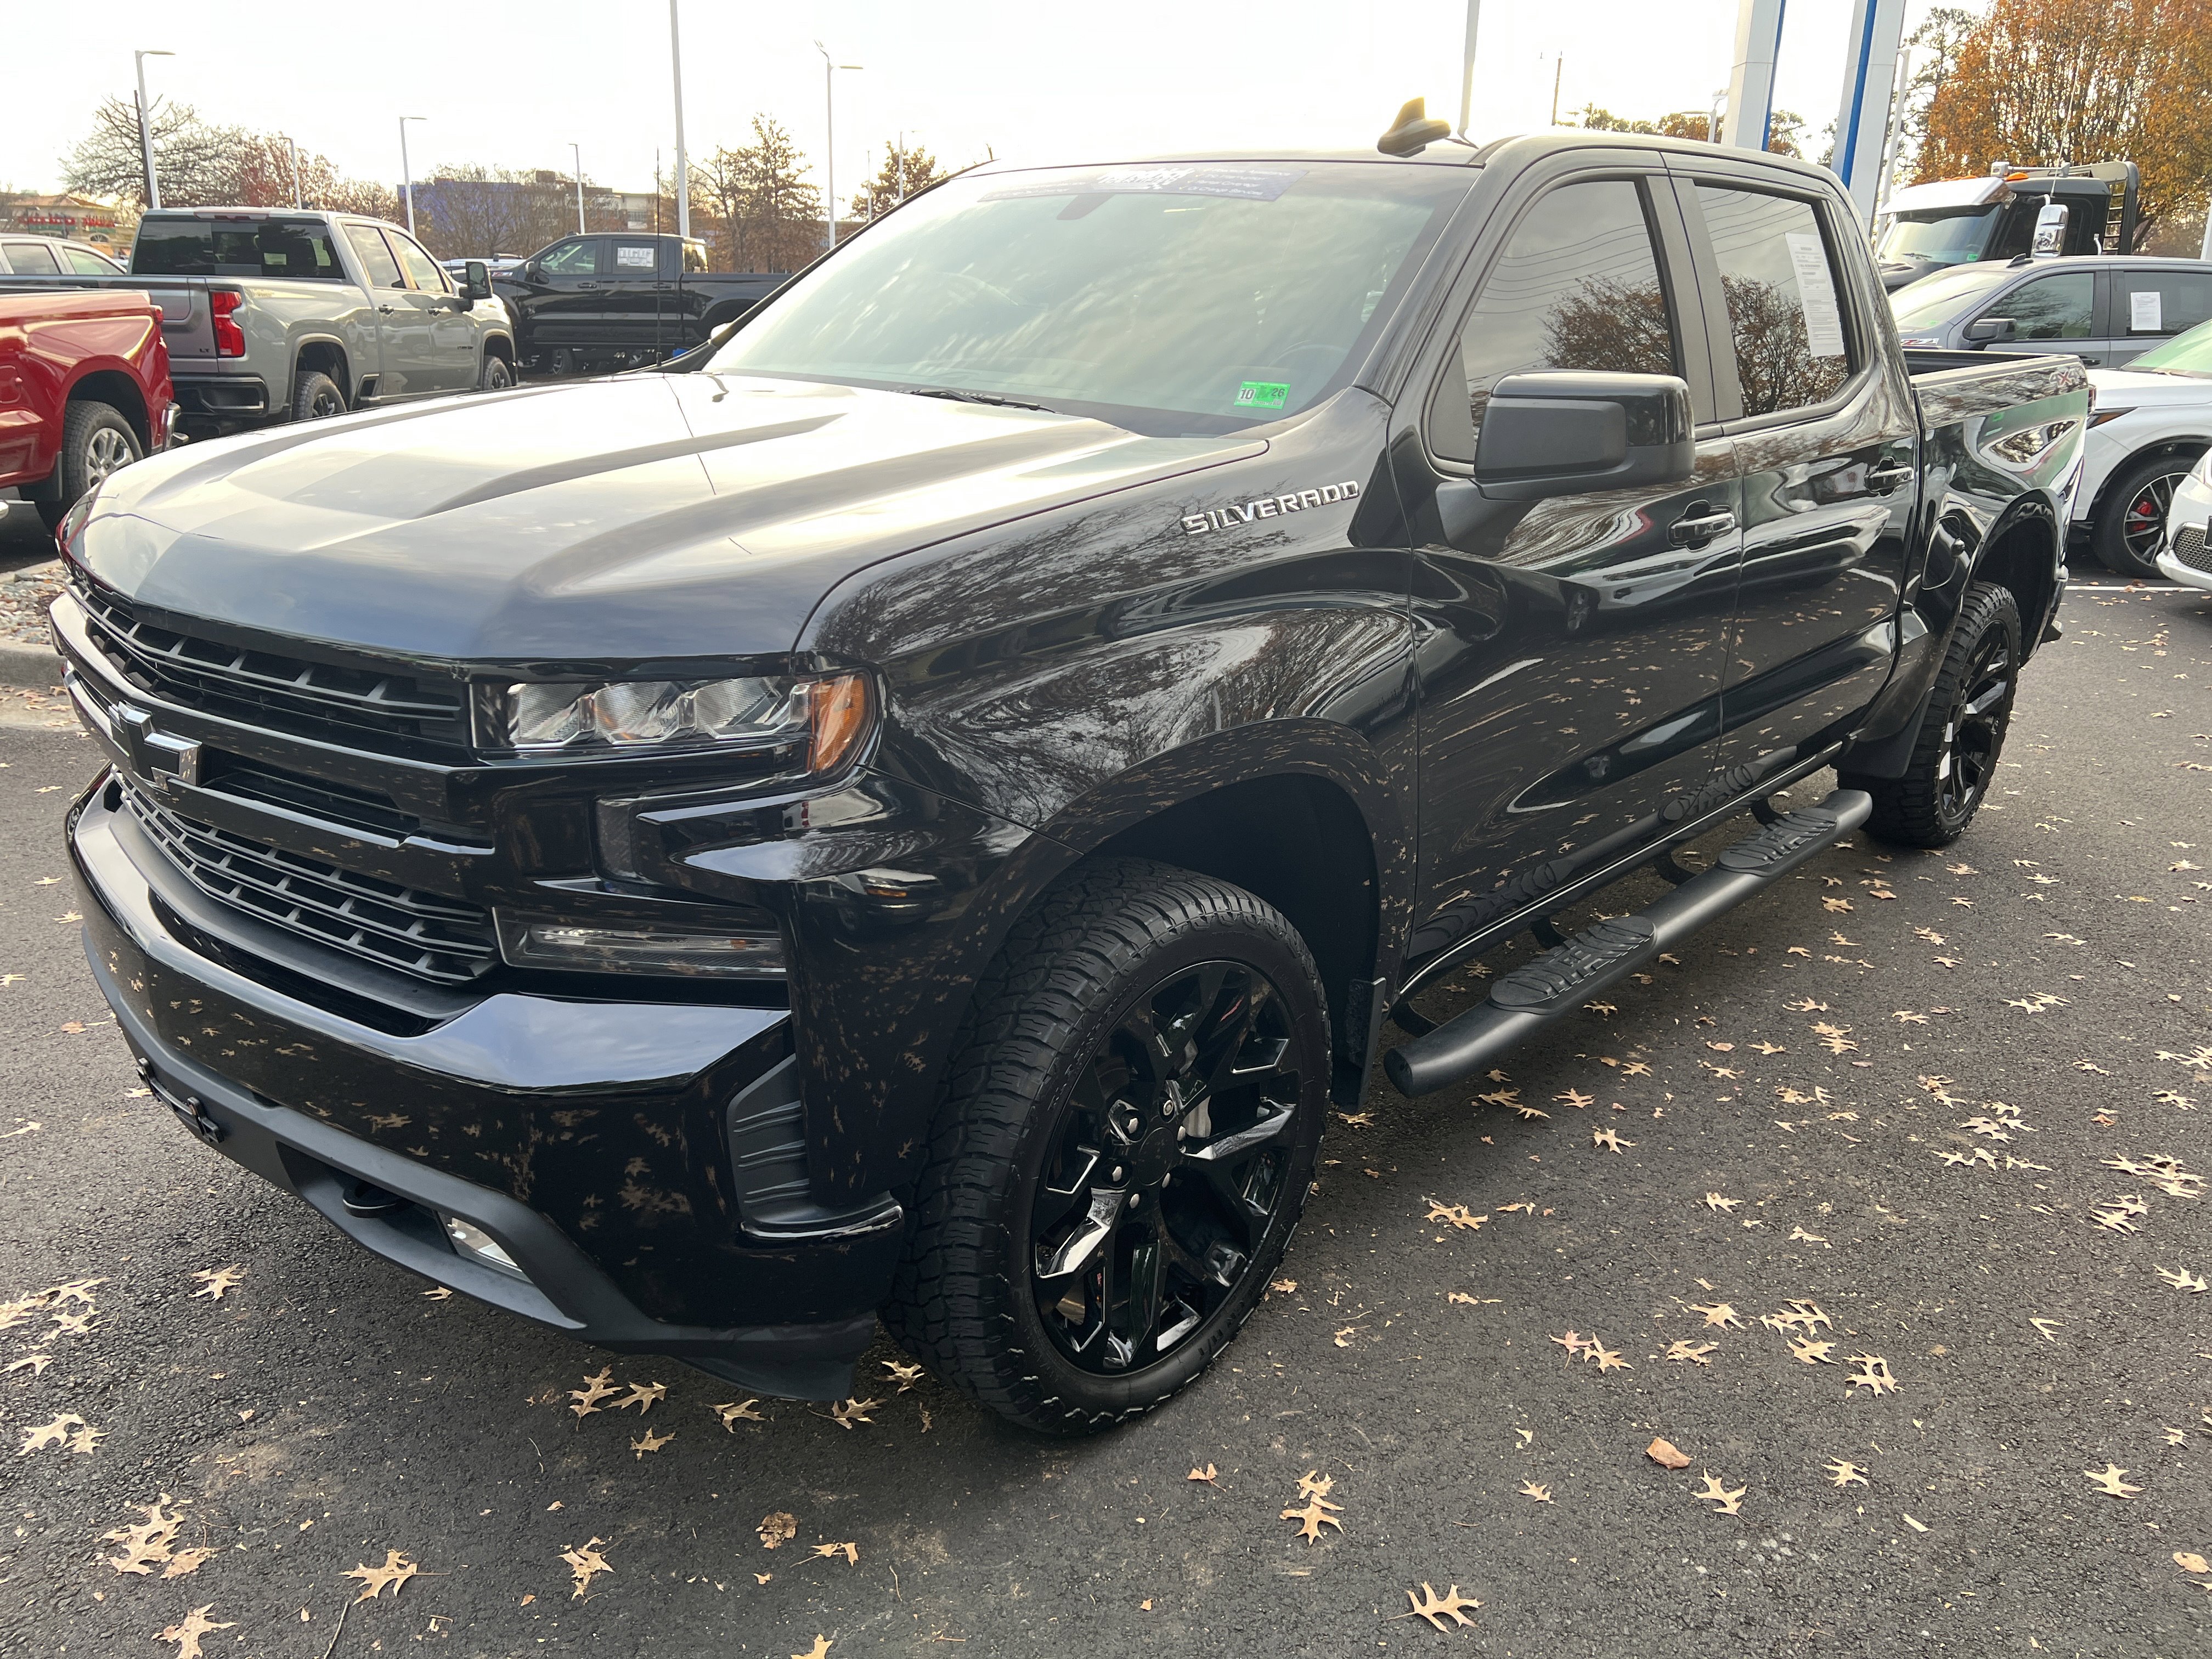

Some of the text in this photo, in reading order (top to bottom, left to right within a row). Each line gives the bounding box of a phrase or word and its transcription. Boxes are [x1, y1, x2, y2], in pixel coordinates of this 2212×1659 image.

[1240, 387, 1285, 399] 10 26
[1180, 480, 1360, 536] SILVERADO
